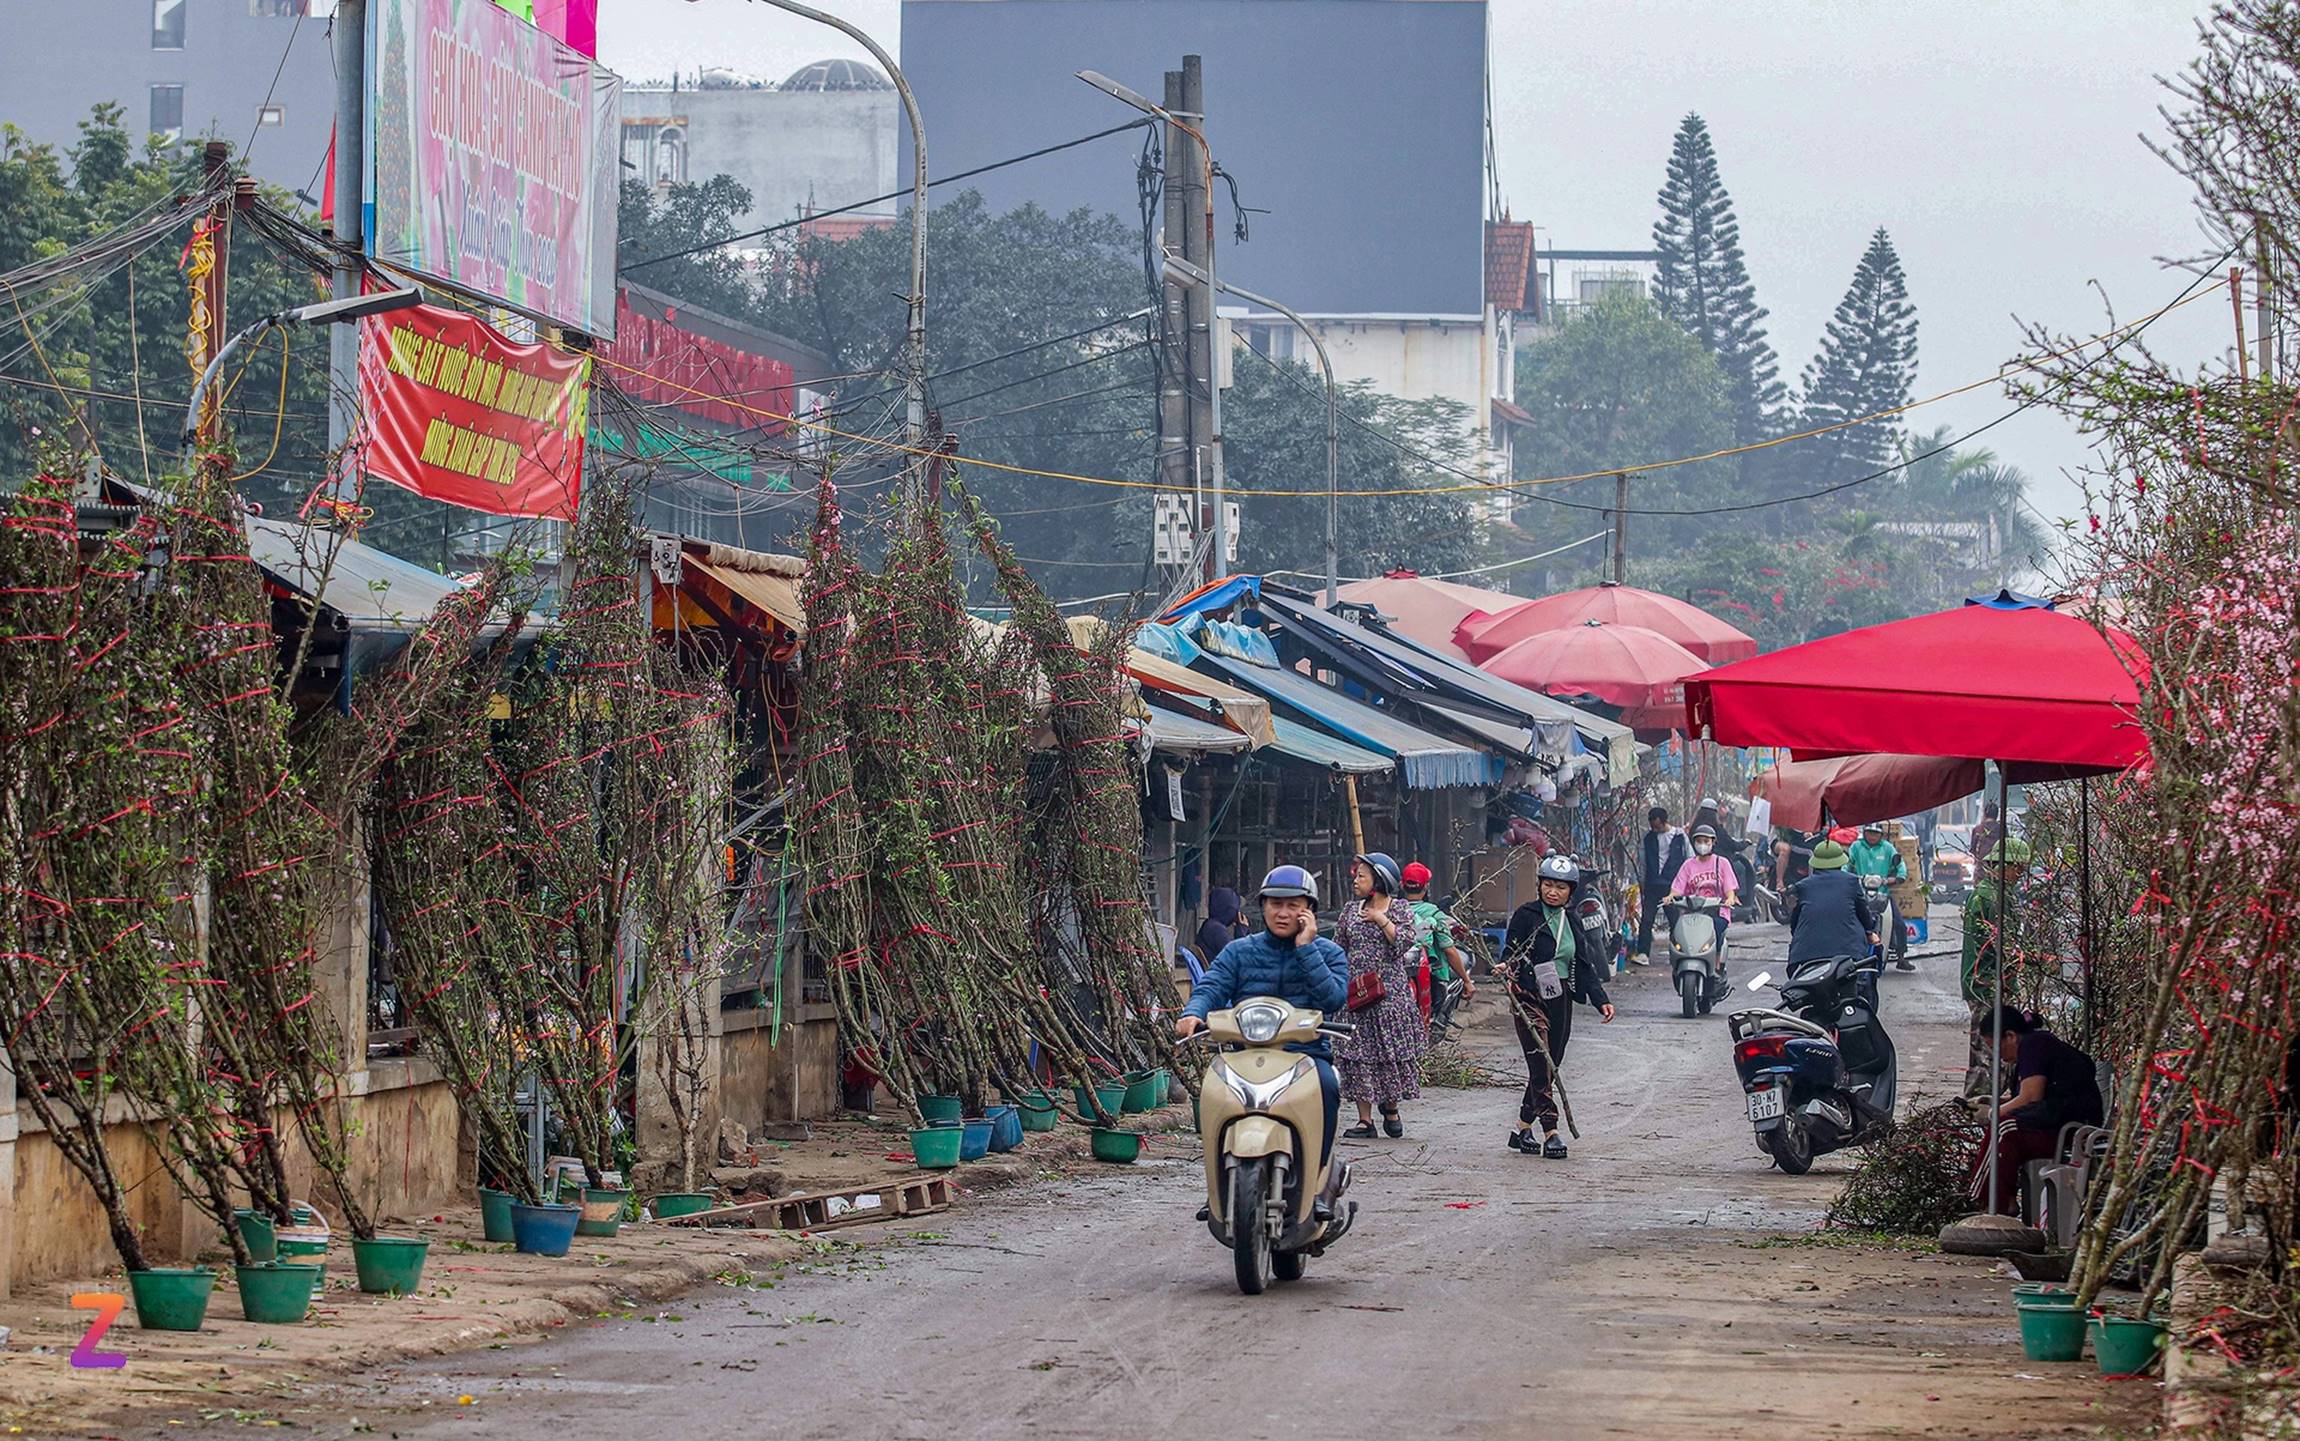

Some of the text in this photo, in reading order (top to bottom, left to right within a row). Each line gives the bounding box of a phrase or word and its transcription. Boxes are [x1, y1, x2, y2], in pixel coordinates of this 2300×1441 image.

[429, 26, 457, 164] CHỢ
[488, 39, 514, 170] CÂY
[513, 48, 546, 186] CẢNH
[564, 74, 582, 203] HỒ
[387, 320, 424, 380] MỪNG
[416, 326, 446, 387] ĐẤT
[435, 341, 469, 397] NƯỚC
[461, 341, 485, 401] ĐỔI
[420, 411, 455, 468] MỪNG
[444, 421, 478, 474] XUÂN
[1752, 1102, 1778, 1119] 6107
